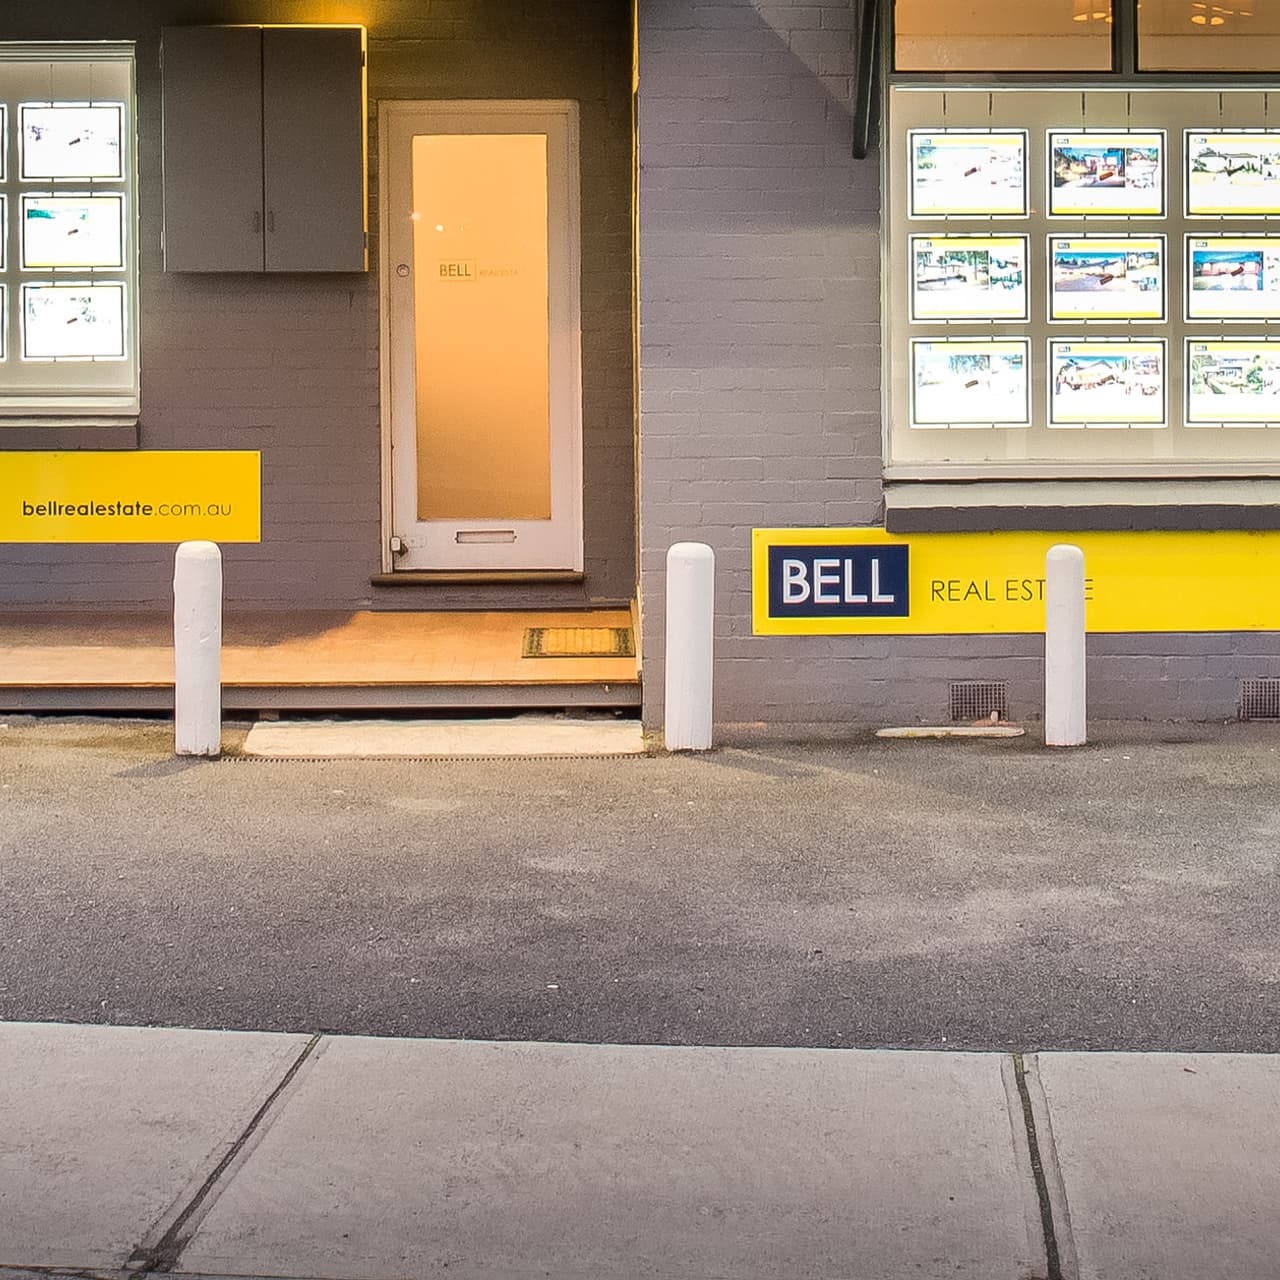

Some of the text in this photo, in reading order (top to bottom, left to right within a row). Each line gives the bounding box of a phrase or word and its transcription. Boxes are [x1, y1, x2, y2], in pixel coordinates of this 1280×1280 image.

[439, 263, 471, 277] BELL
[22, 500, 233, 517] bellrealestate.com.au
[781, 558, 1095, 605] BELL REAL ESTE
